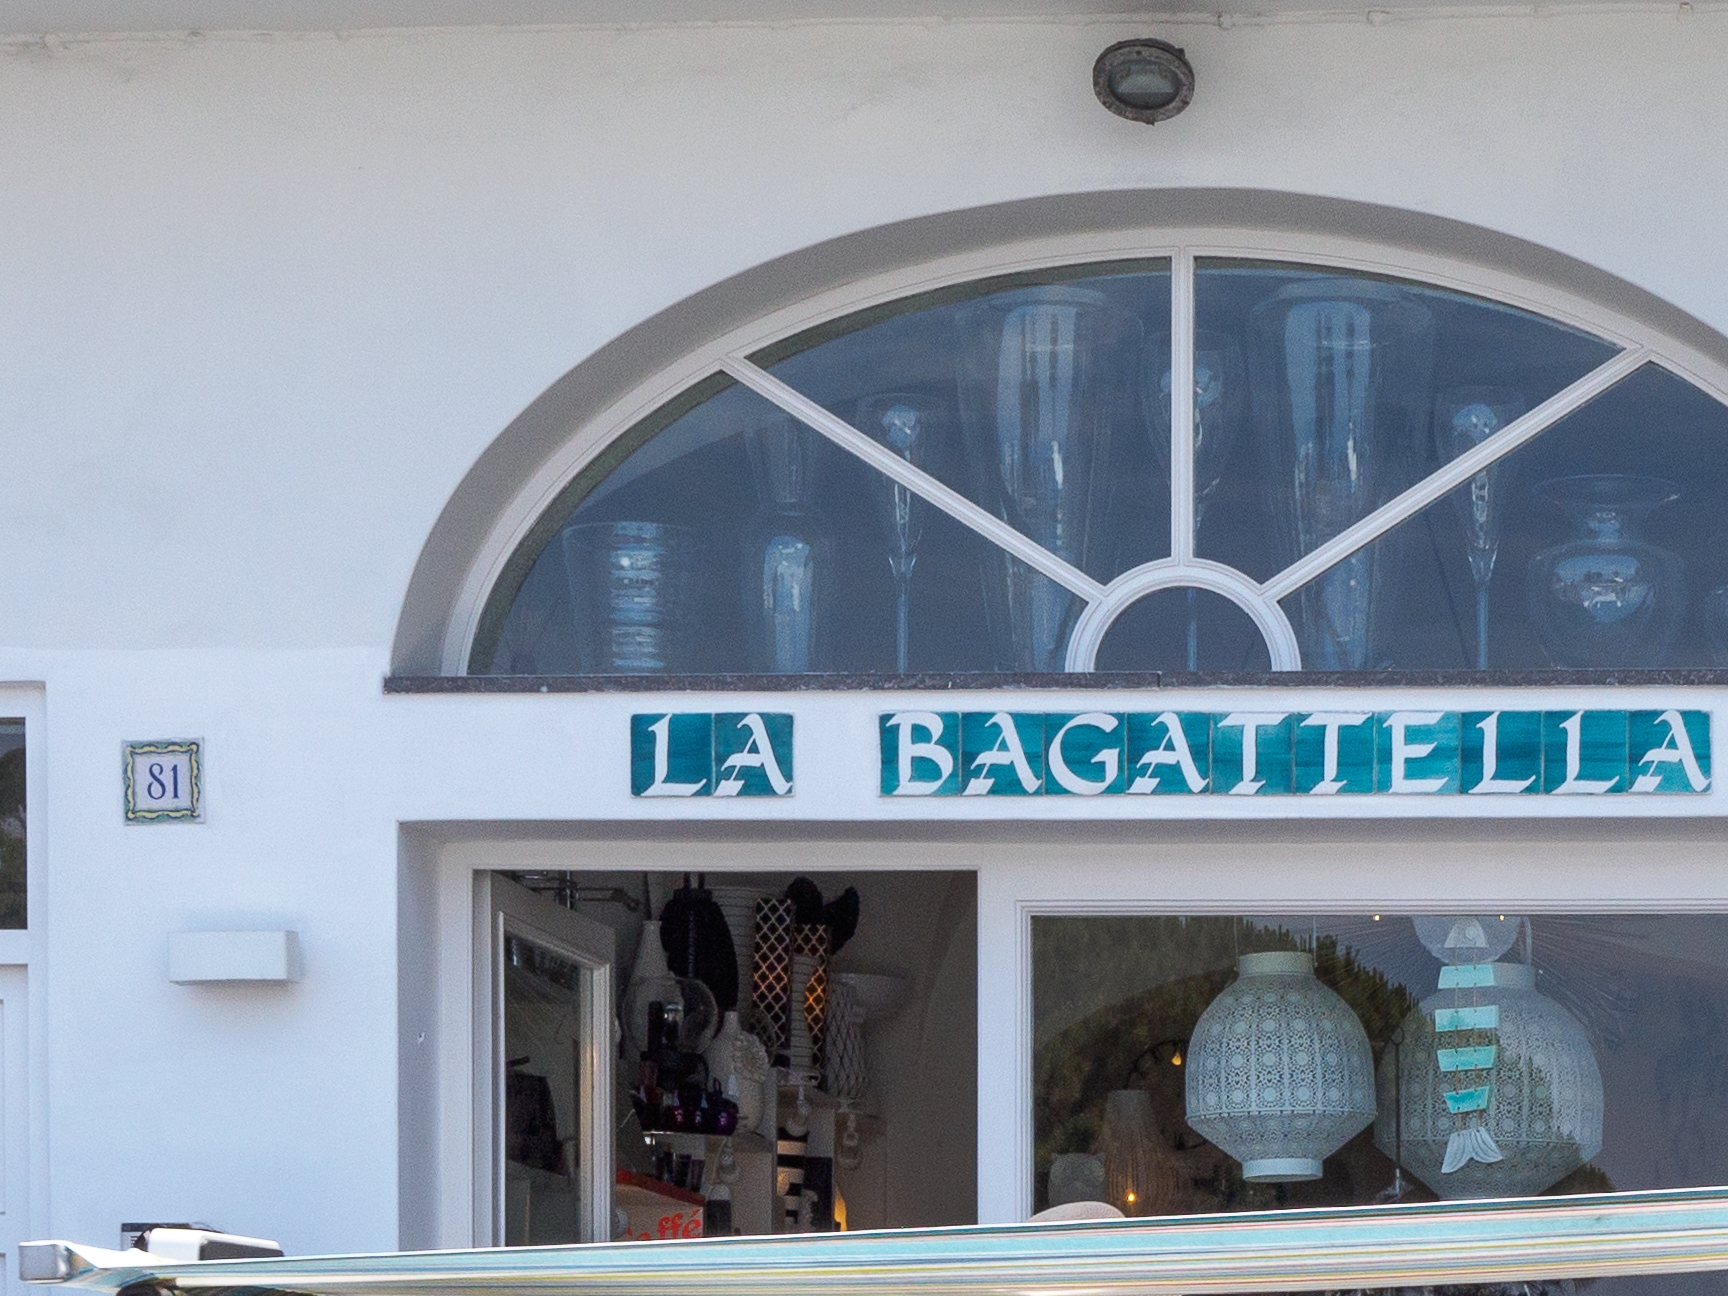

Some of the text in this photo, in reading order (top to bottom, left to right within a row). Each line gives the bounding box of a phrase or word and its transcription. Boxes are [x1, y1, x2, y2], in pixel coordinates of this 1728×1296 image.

[147, 762, 180, 800] 81
[641, 710, 1711, 796] LA BAGATTELLA
